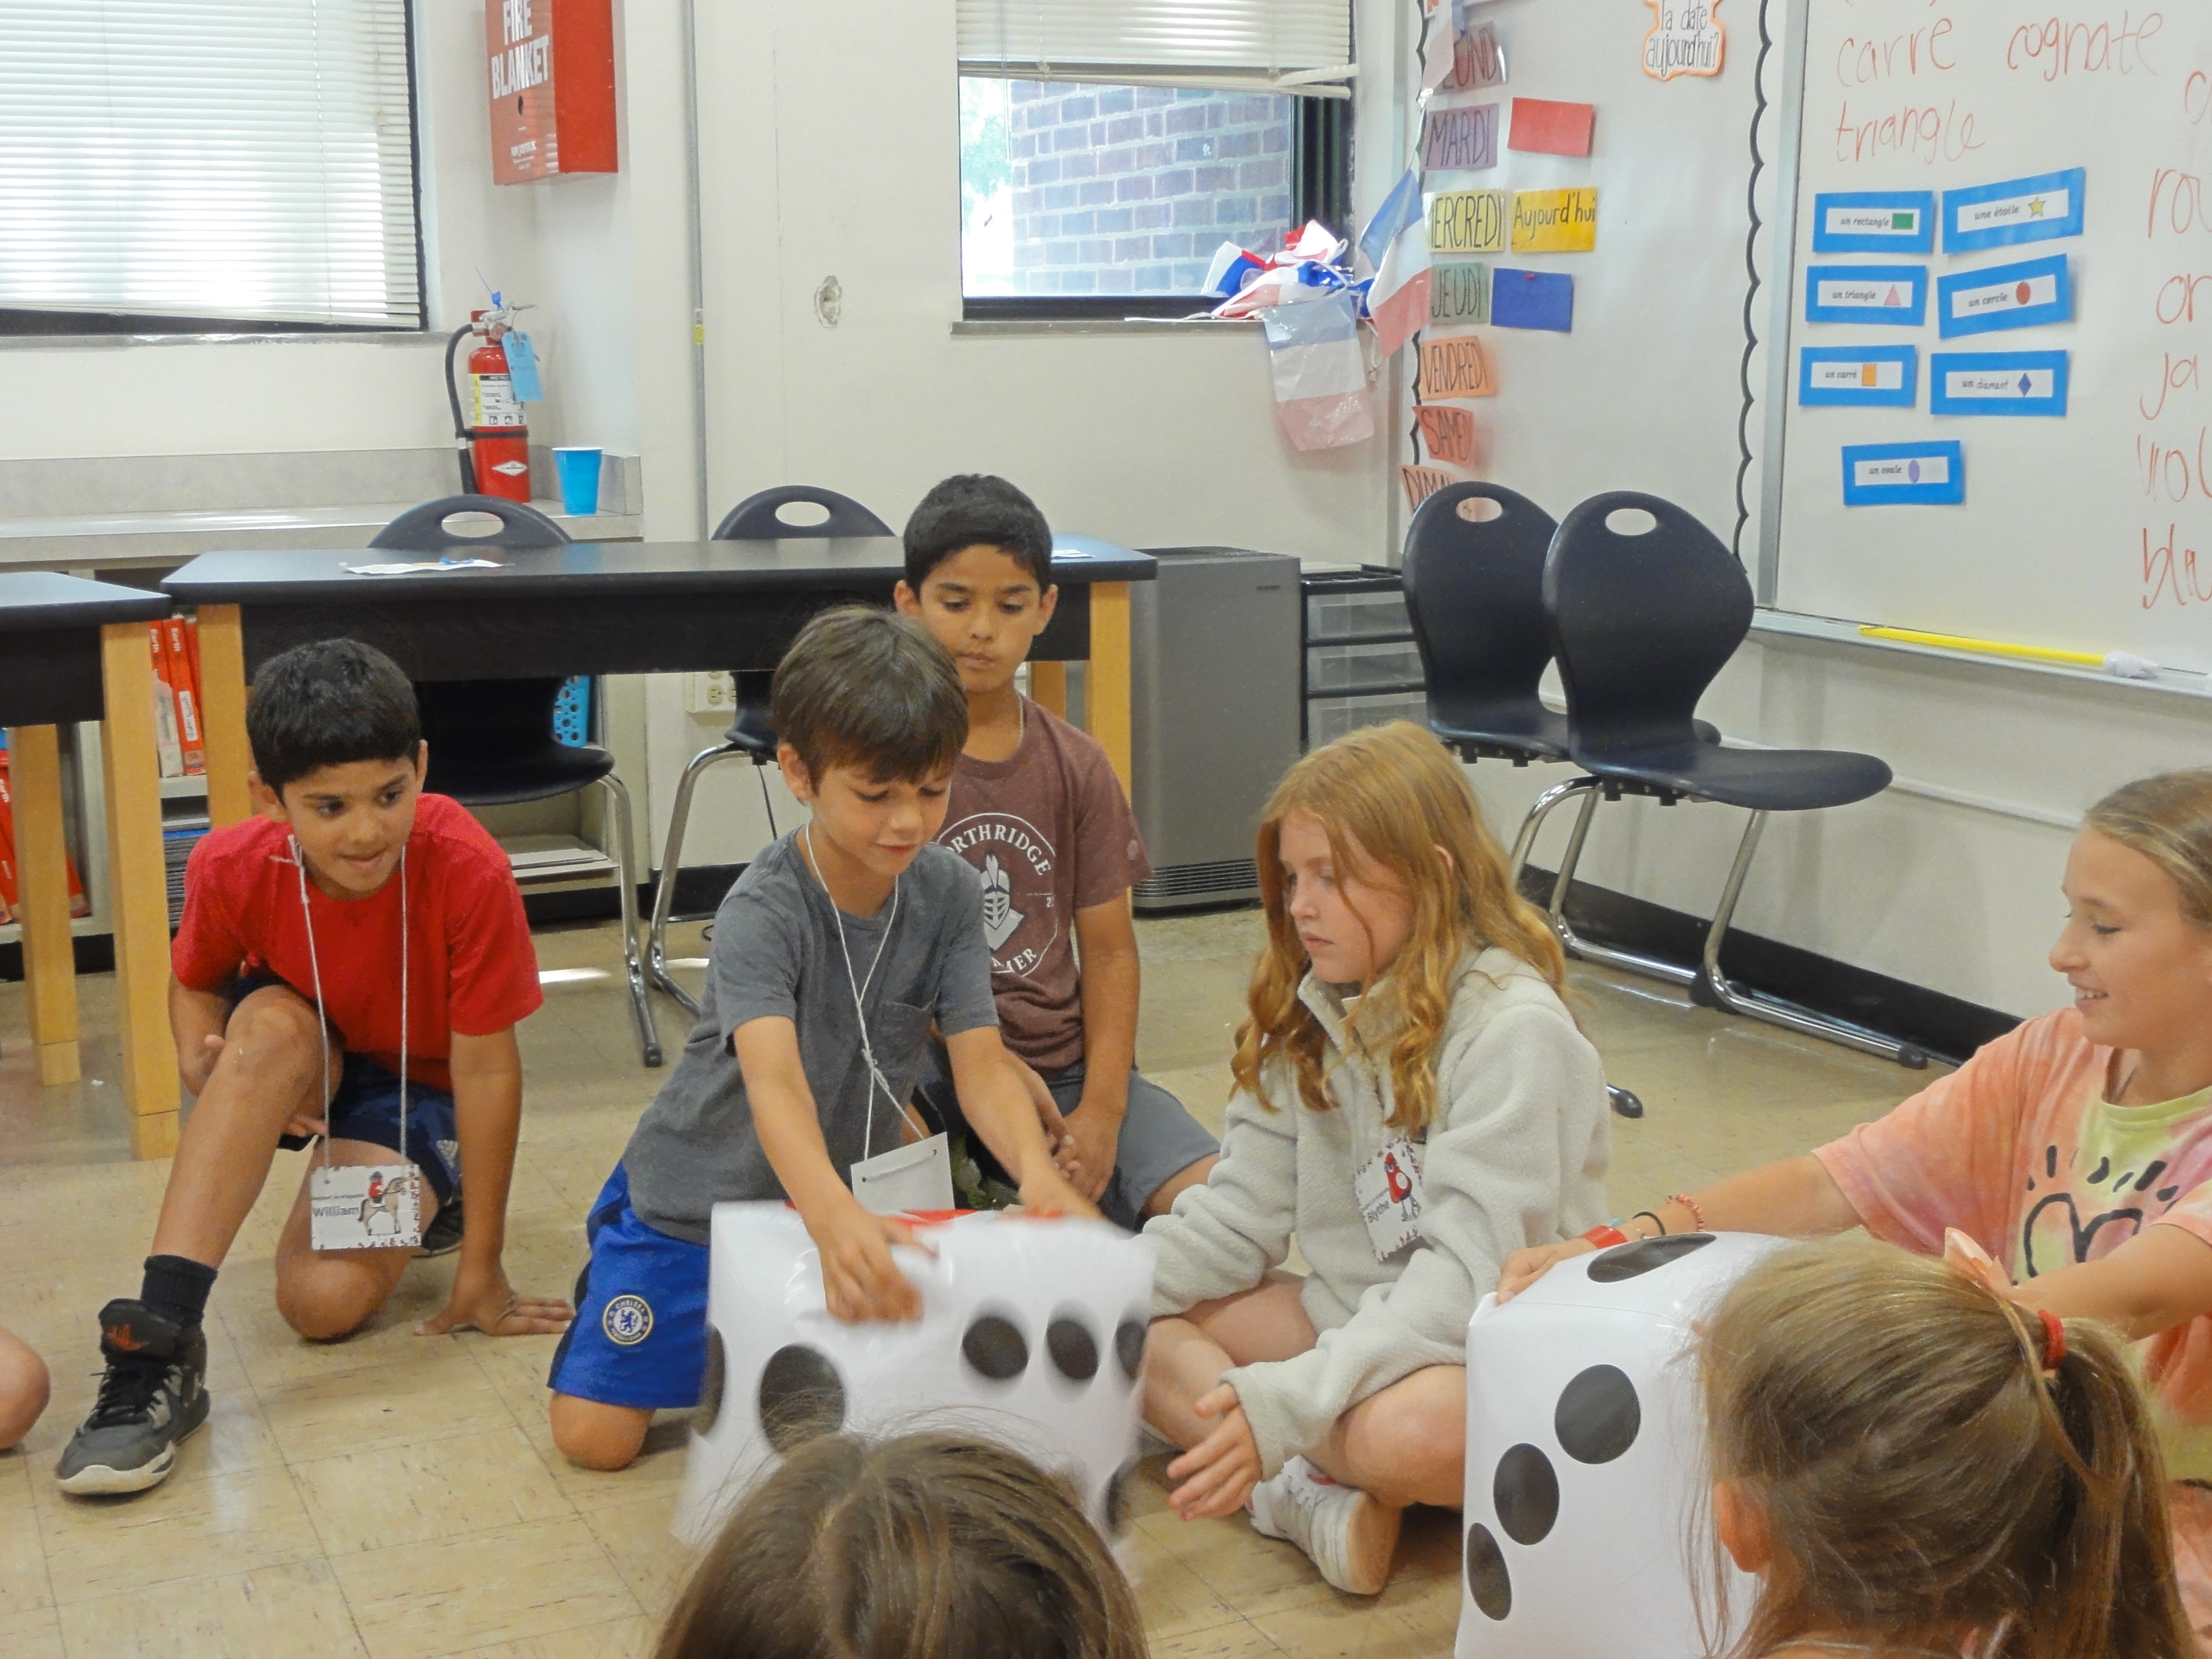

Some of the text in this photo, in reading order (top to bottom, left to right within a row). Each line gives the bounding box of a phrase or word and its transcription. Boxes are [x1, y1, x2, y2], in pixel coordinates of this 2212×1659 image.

[503, 0, 532, 45] FIRE
[491, 35, 549, 99] BLANKET
[1426, 110, 1490, 167] MARDI
[1836, 99, 1986, 165] triangle
[1432, 267, 1481, 318] JEUDI
[1422, 342, 1489, 395] VENDREDI
[946, 824, 1051, 876] RTHRIDGE
